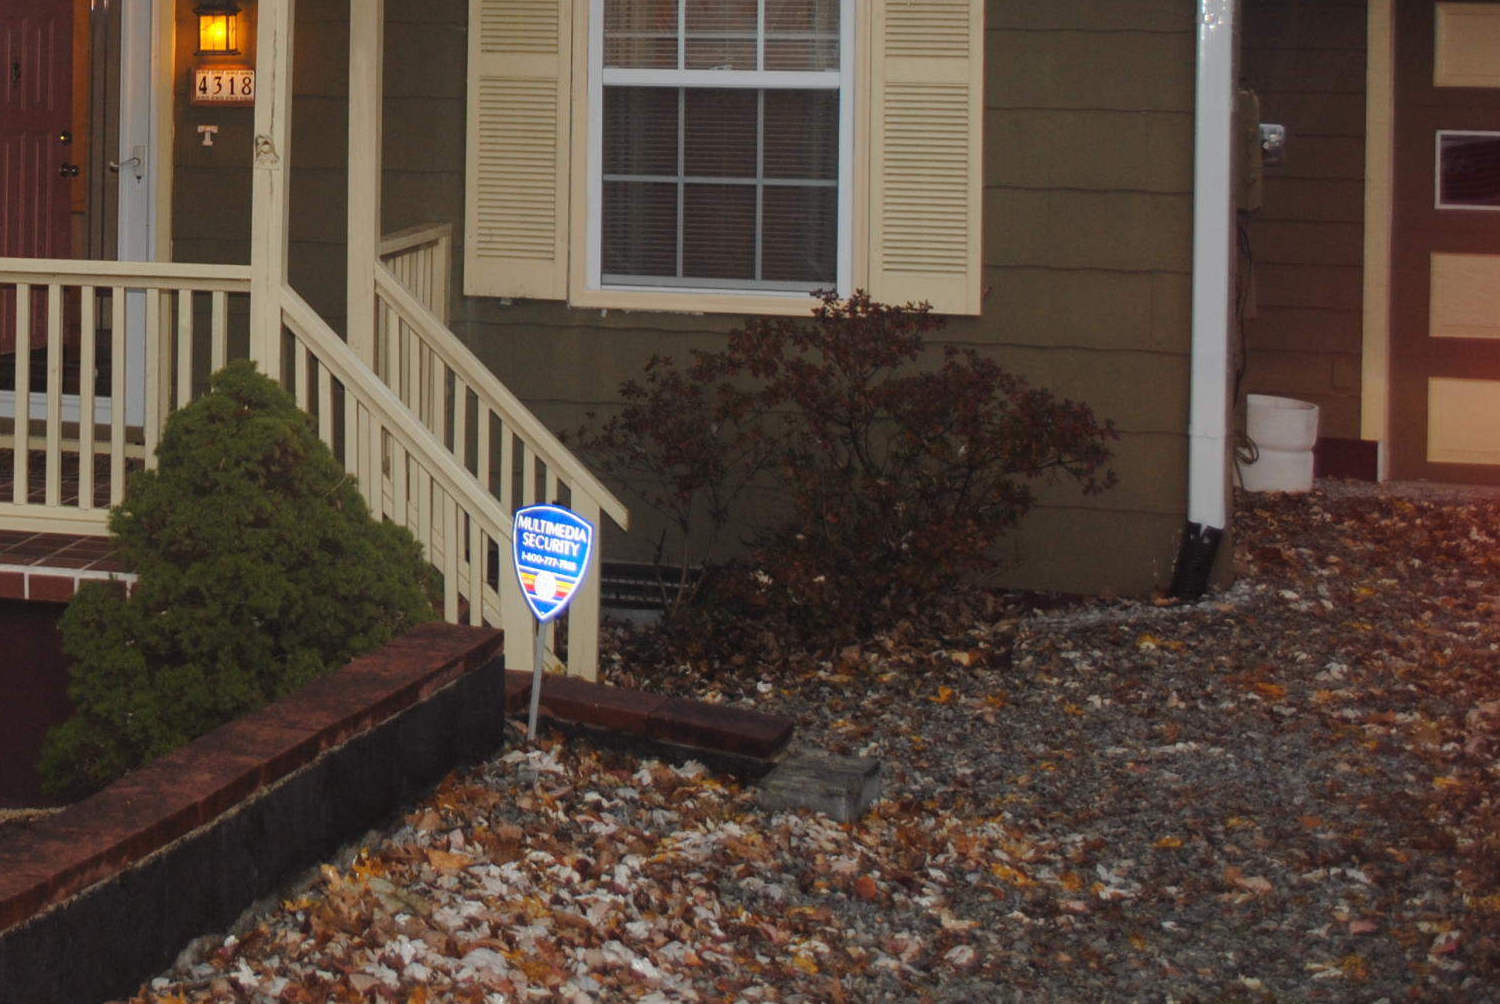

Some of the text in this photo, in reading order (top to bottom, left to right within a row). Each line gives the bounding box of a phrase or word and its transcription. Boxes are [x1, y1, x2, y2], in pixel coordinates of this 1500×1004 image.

[198, 75, 252, 96] 4318
[196, 125, 219, 146] T
[518, 515, 587, 542] MULTIMEDIA
[522, 531, 580, 556] SECURITY
